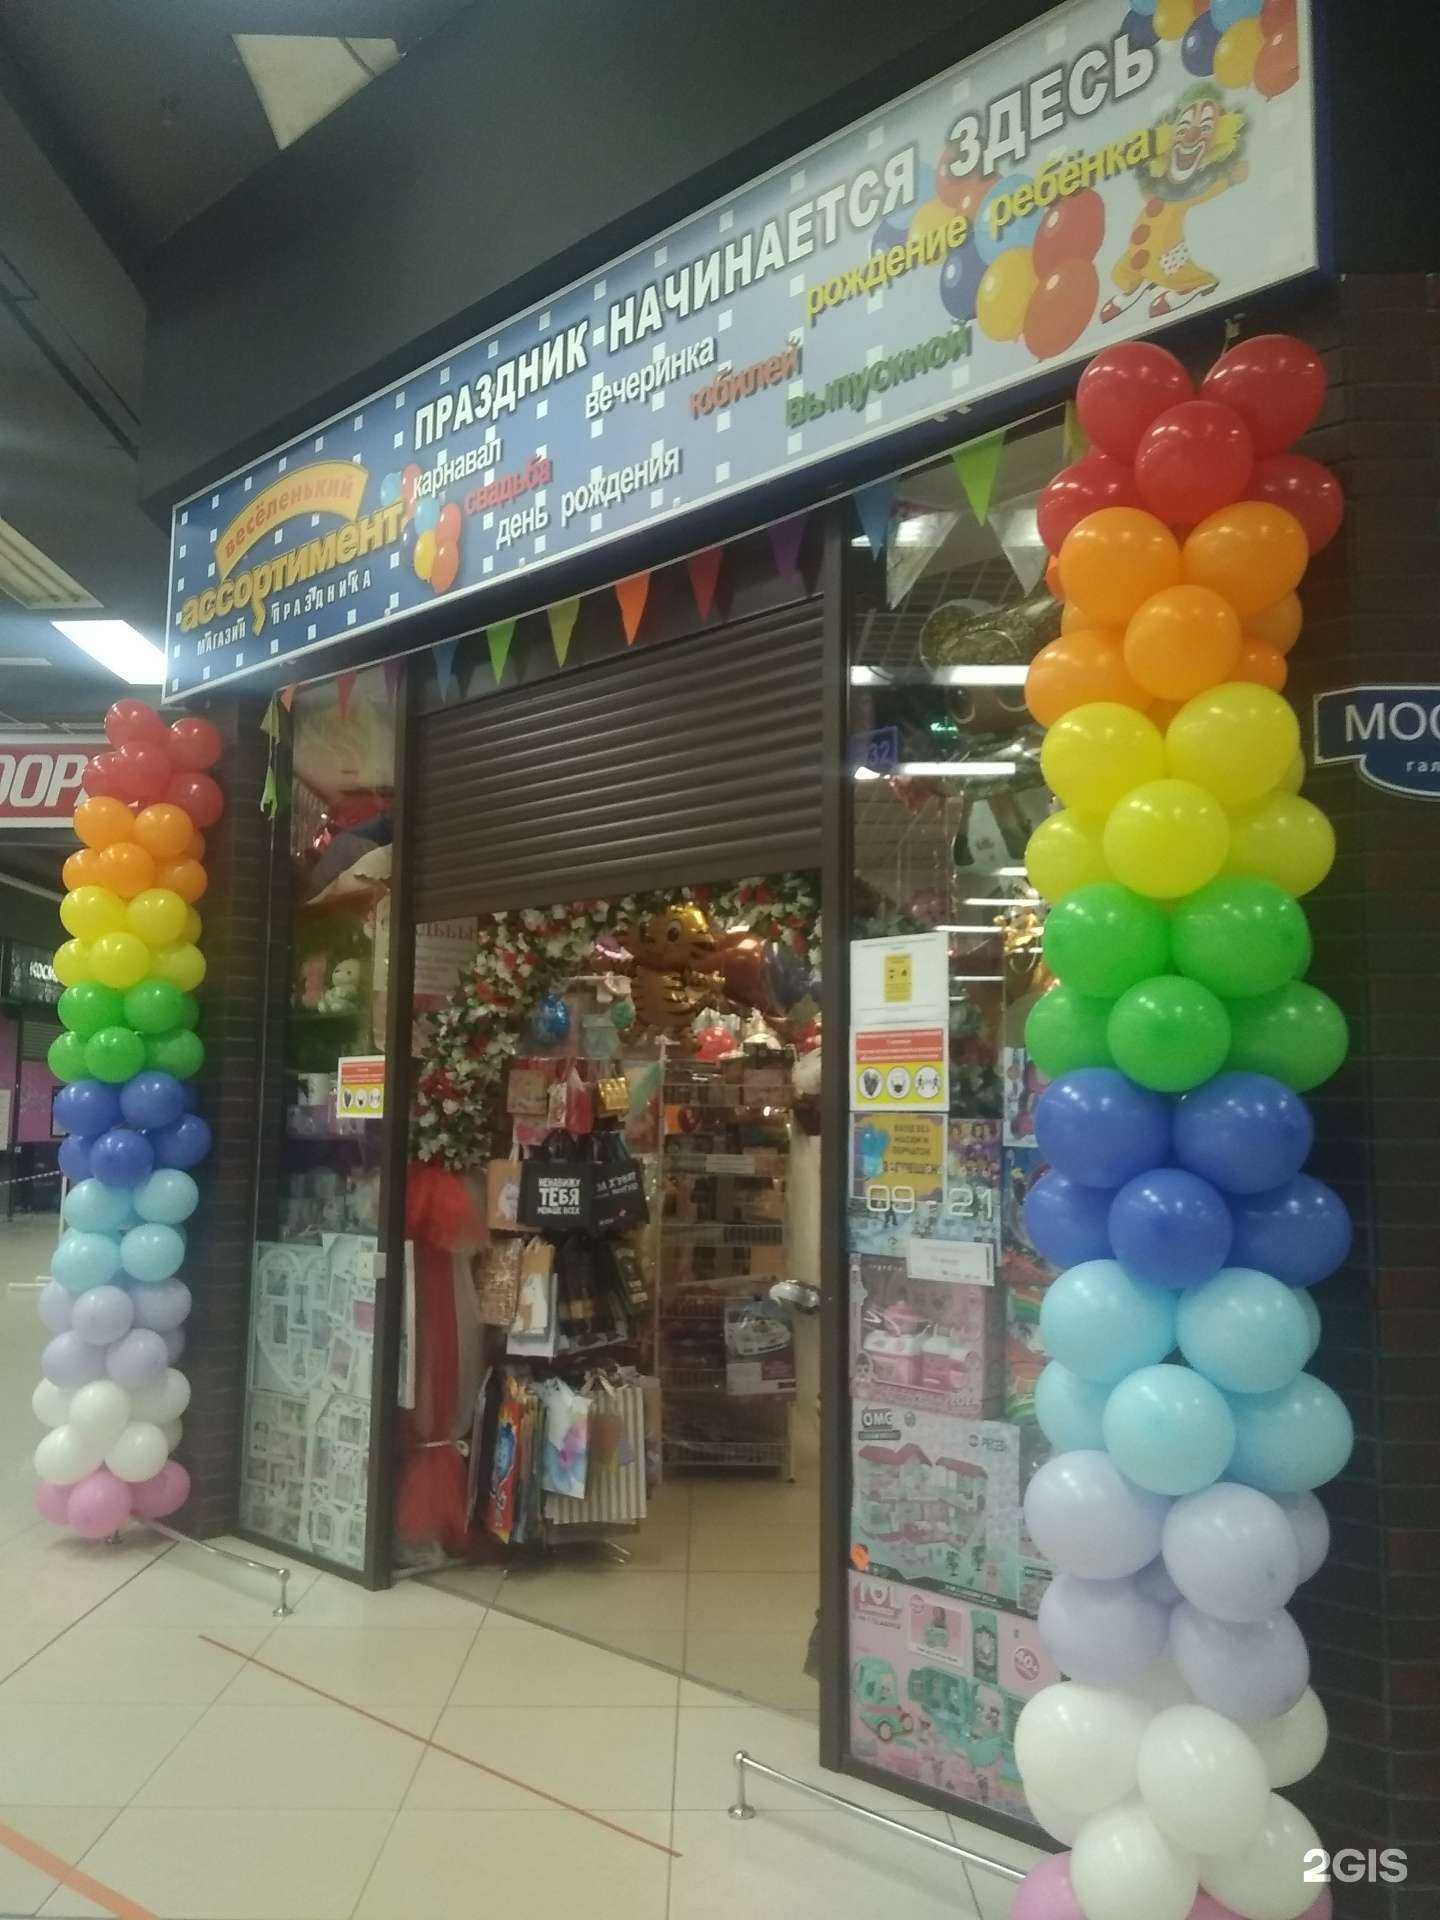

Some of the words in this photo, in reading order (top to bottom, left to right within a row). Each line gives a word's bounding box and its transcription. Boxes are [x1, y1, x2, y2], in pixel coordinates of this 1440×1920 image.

[414, 321, 590, 451] ПРАЗДНИК
[608, 147, 919, 353] НАЧИНАЕТСЯ
[949, 34, 1155, 178] ЗДЕСЬ
[804, 212, 969, 329] рождение
[988, 129, 1153, 241] ребёнка
[585, 335, 716, 420] вечеринка
[689, 336, 802, 420] юбилей
[785, 320, 972, 429] выпускной
[412, 437, 503, 500] карнавал
[464, 454, 554, 517] свадьба
[495, 503, 550, 550] день
[561, 446, 681, 522] рождения
[224, 474, 355, 559] весёленький
[180, 501, 405, 636] ассортимент
[197, 617, 246, 656] МАГАЗИН
[271, 569, 372, 626] ПРАЗДНИКА
[538, 1186, 580, 1207] ТЕБЯ
[948, 1188, 993, 1219] 21
